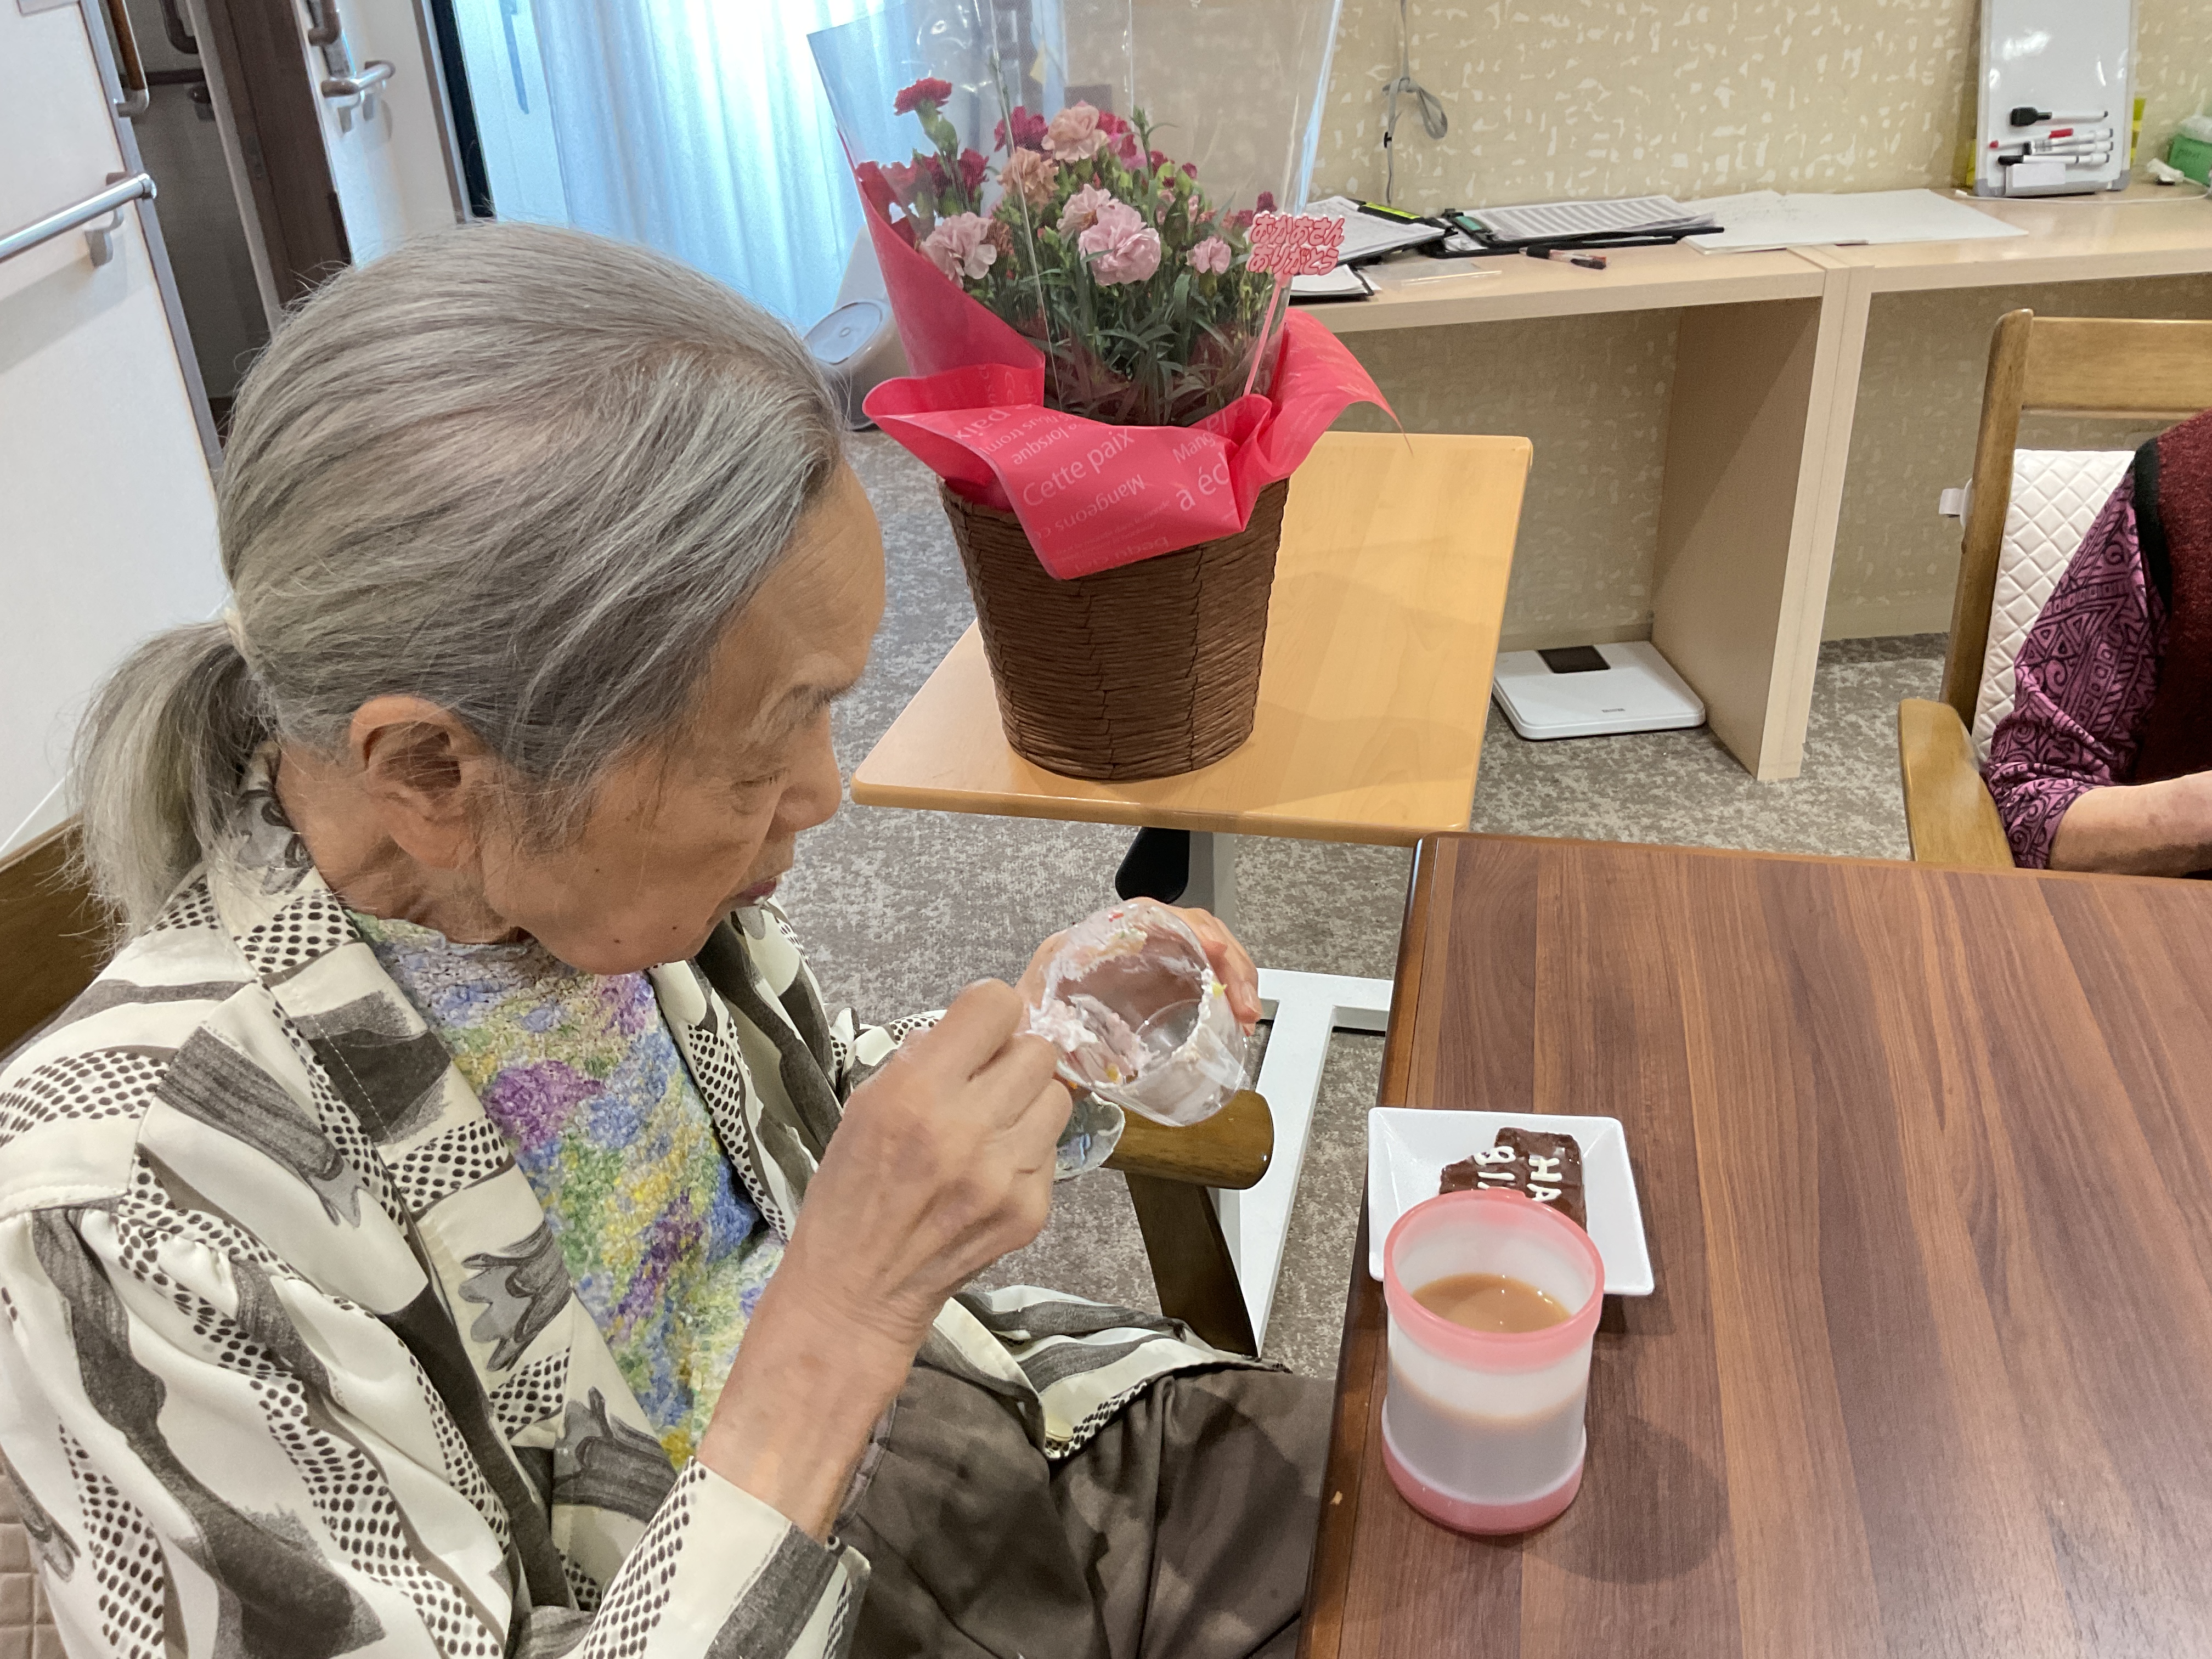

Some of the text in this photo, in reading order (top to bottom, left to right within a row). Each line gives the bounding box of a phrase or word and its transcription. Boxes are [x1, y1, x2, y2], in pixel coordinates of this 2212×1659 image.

[1251, 214, 1345, 247] おかあさん
[1249, 245, 1340, 275] ありがとう
[1011, 427, 1070, 465] lorsque
[1023, 428, 1135, 506] Cette paix
[1055, 474, 1146, 531] Mangeons
